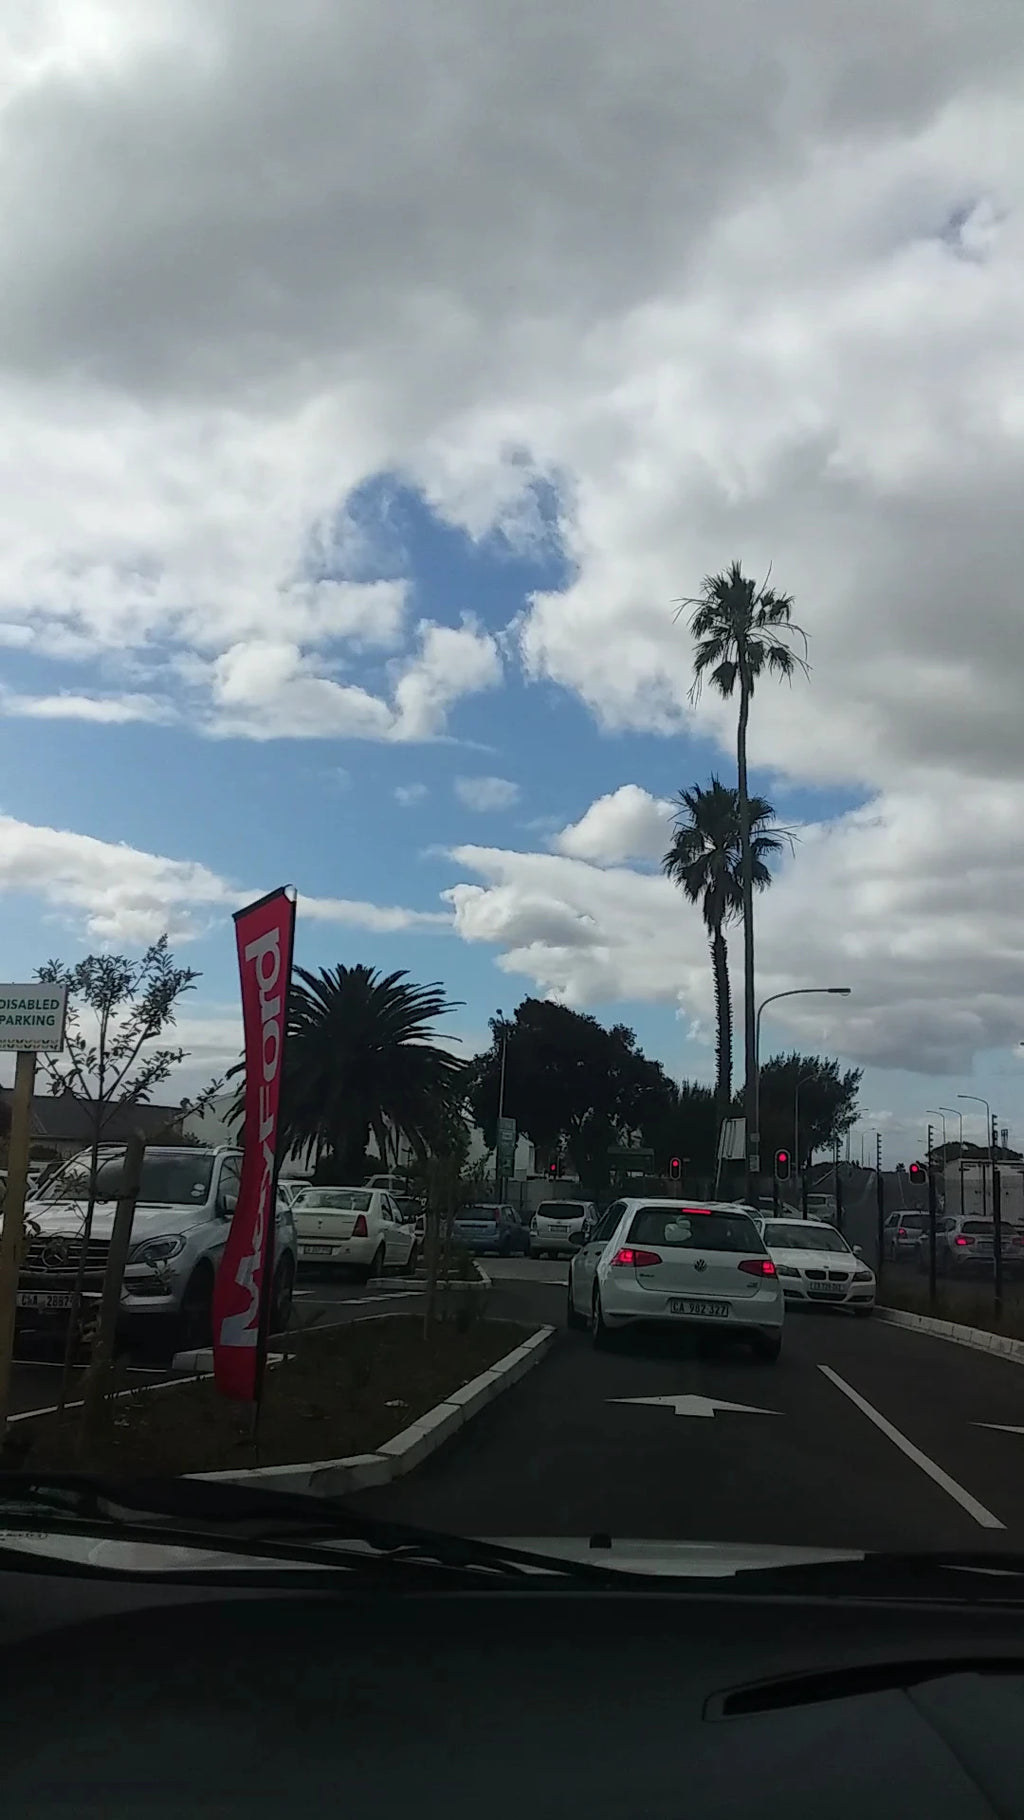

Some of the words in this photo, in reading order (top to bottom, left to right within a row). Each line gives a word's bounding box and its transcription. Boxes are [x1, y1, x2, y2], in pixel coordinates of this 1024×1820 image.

[0, 999, 60, 1010] DISABLED
[0, 1014, 55, 1026] PARKING
[672, 1301, 685, 1312] CA
